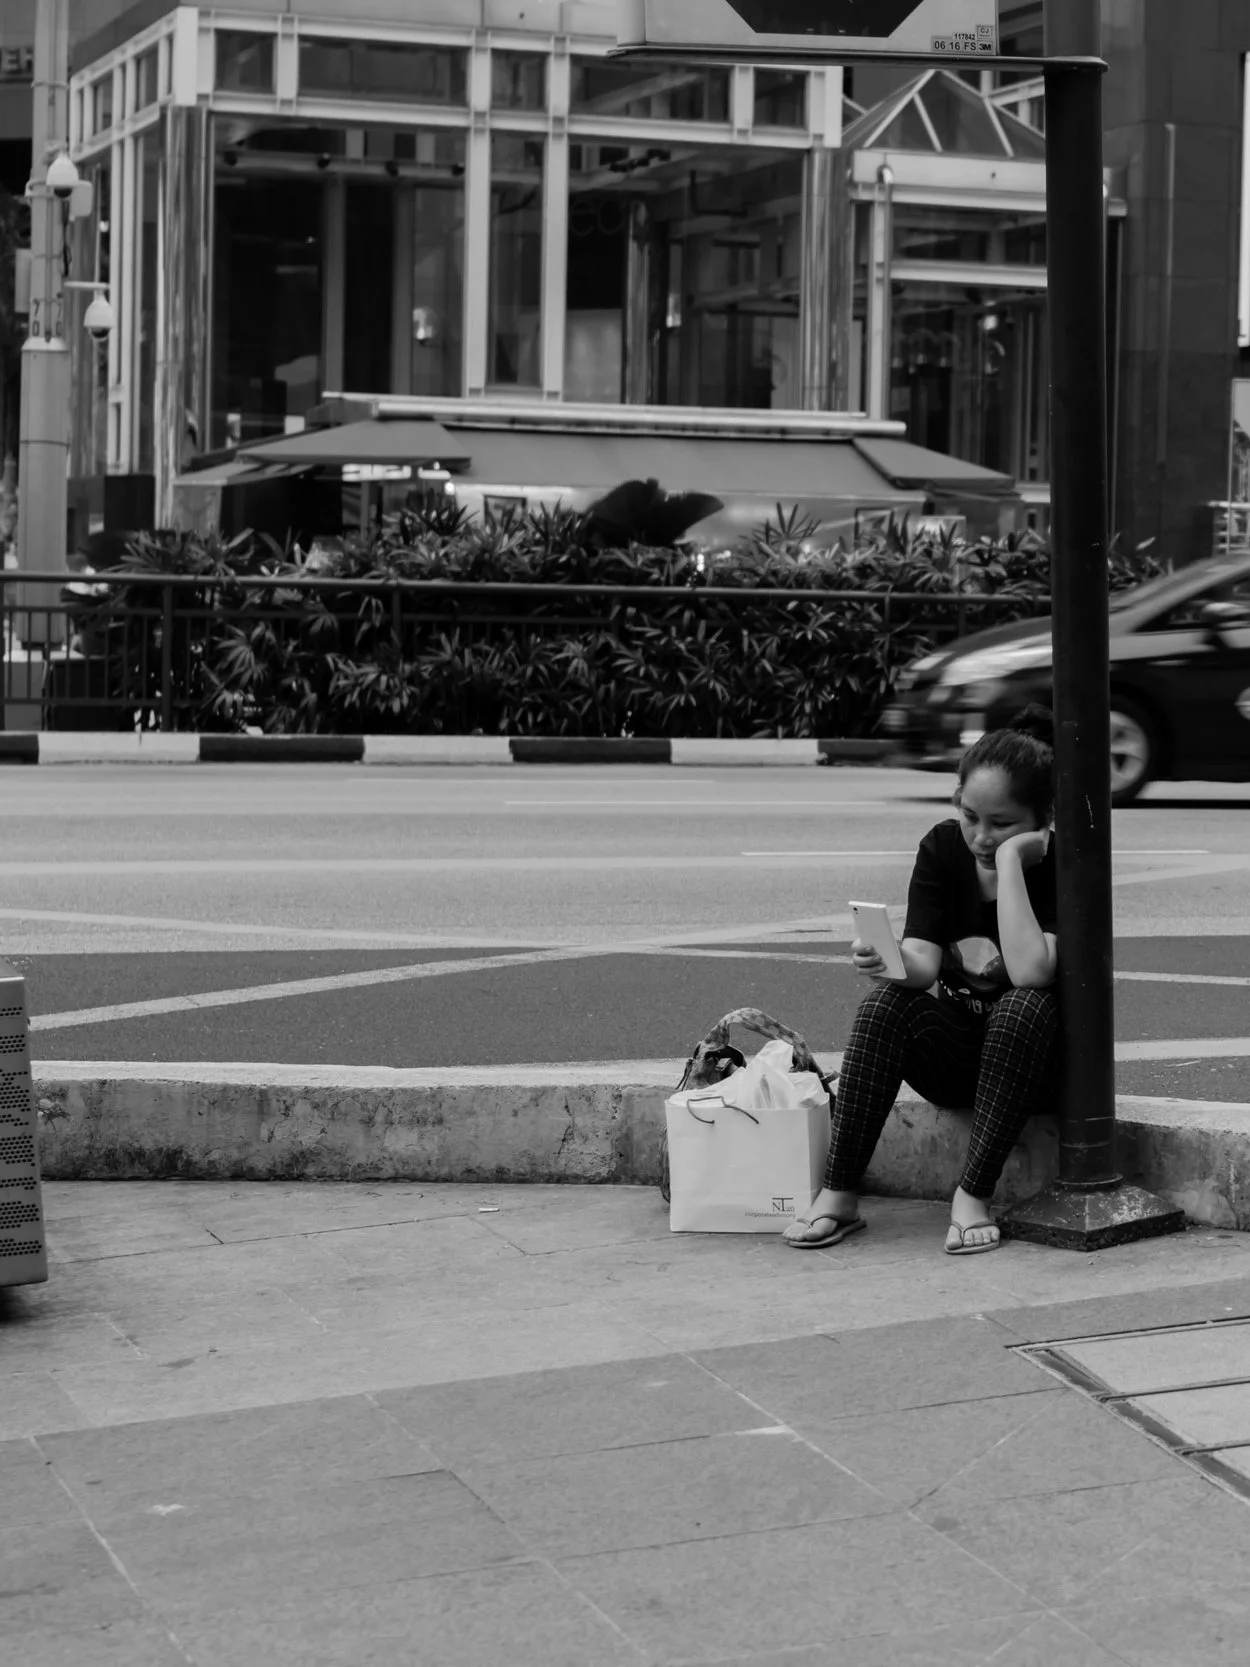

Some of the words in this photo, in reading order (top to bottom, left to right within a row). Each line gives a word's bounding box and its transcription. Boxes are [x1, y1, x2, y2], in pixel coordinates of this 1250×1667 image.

[954, 33, 976, 41] 117842
[934, 40, 946, 50] 06
[949, 41, 961, 51] 16
[964, 41, 977, 51] FS
[978, 43, 992, 51] 3M
